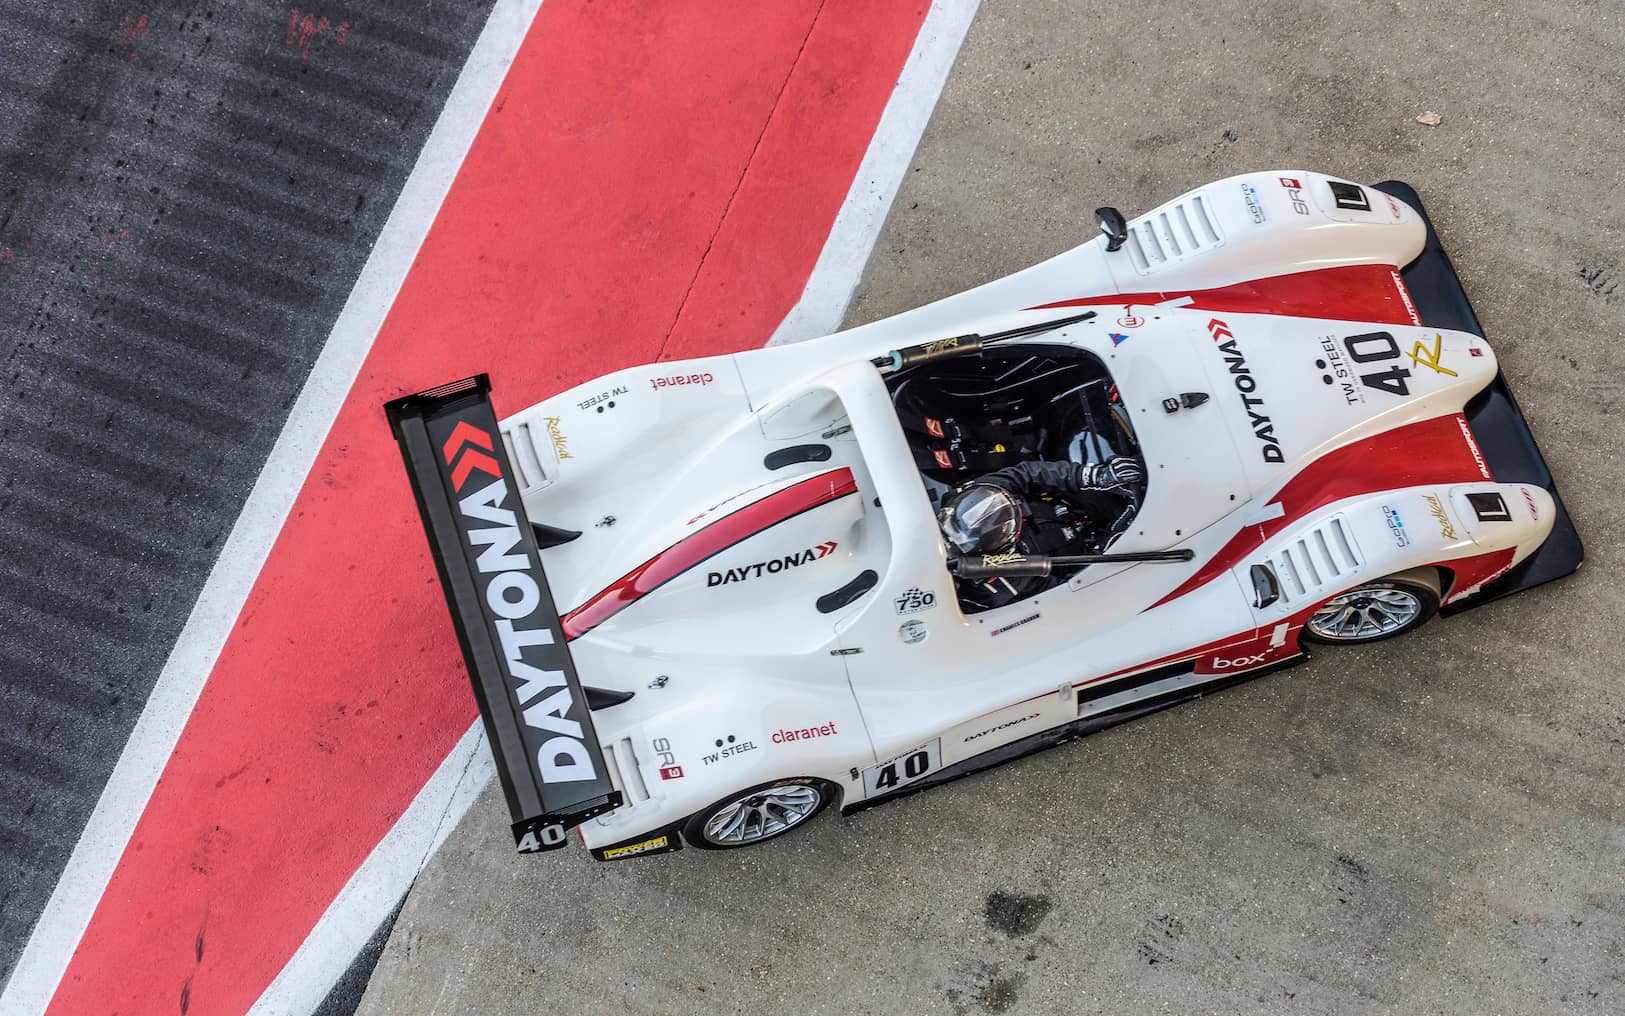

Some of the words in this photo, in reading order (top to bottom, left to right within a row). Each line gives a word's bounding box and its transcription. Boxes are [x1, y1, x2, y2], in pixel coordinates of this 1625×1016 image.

[1322, 335, 1348, 378] STEEL
[1345, 331, 1411, 395] 40
[649, 372, 714, 390] claranet
[577, 391, 610, 410] STEEL
[1218, 340, 1285, 463] DAYTONA
[707, 549, 817, 587] DAYTONA
[896, 593, 934, 611] 750
[458, 478, 597, 783] DAYTONA
[771, 721, 838, 745] claranet
[702, 750, 720, 766] TW
[722, 740, 758, 759] STEEL
[875, 751, 930, 790] 40
[518, 825, 567, 852] 40
